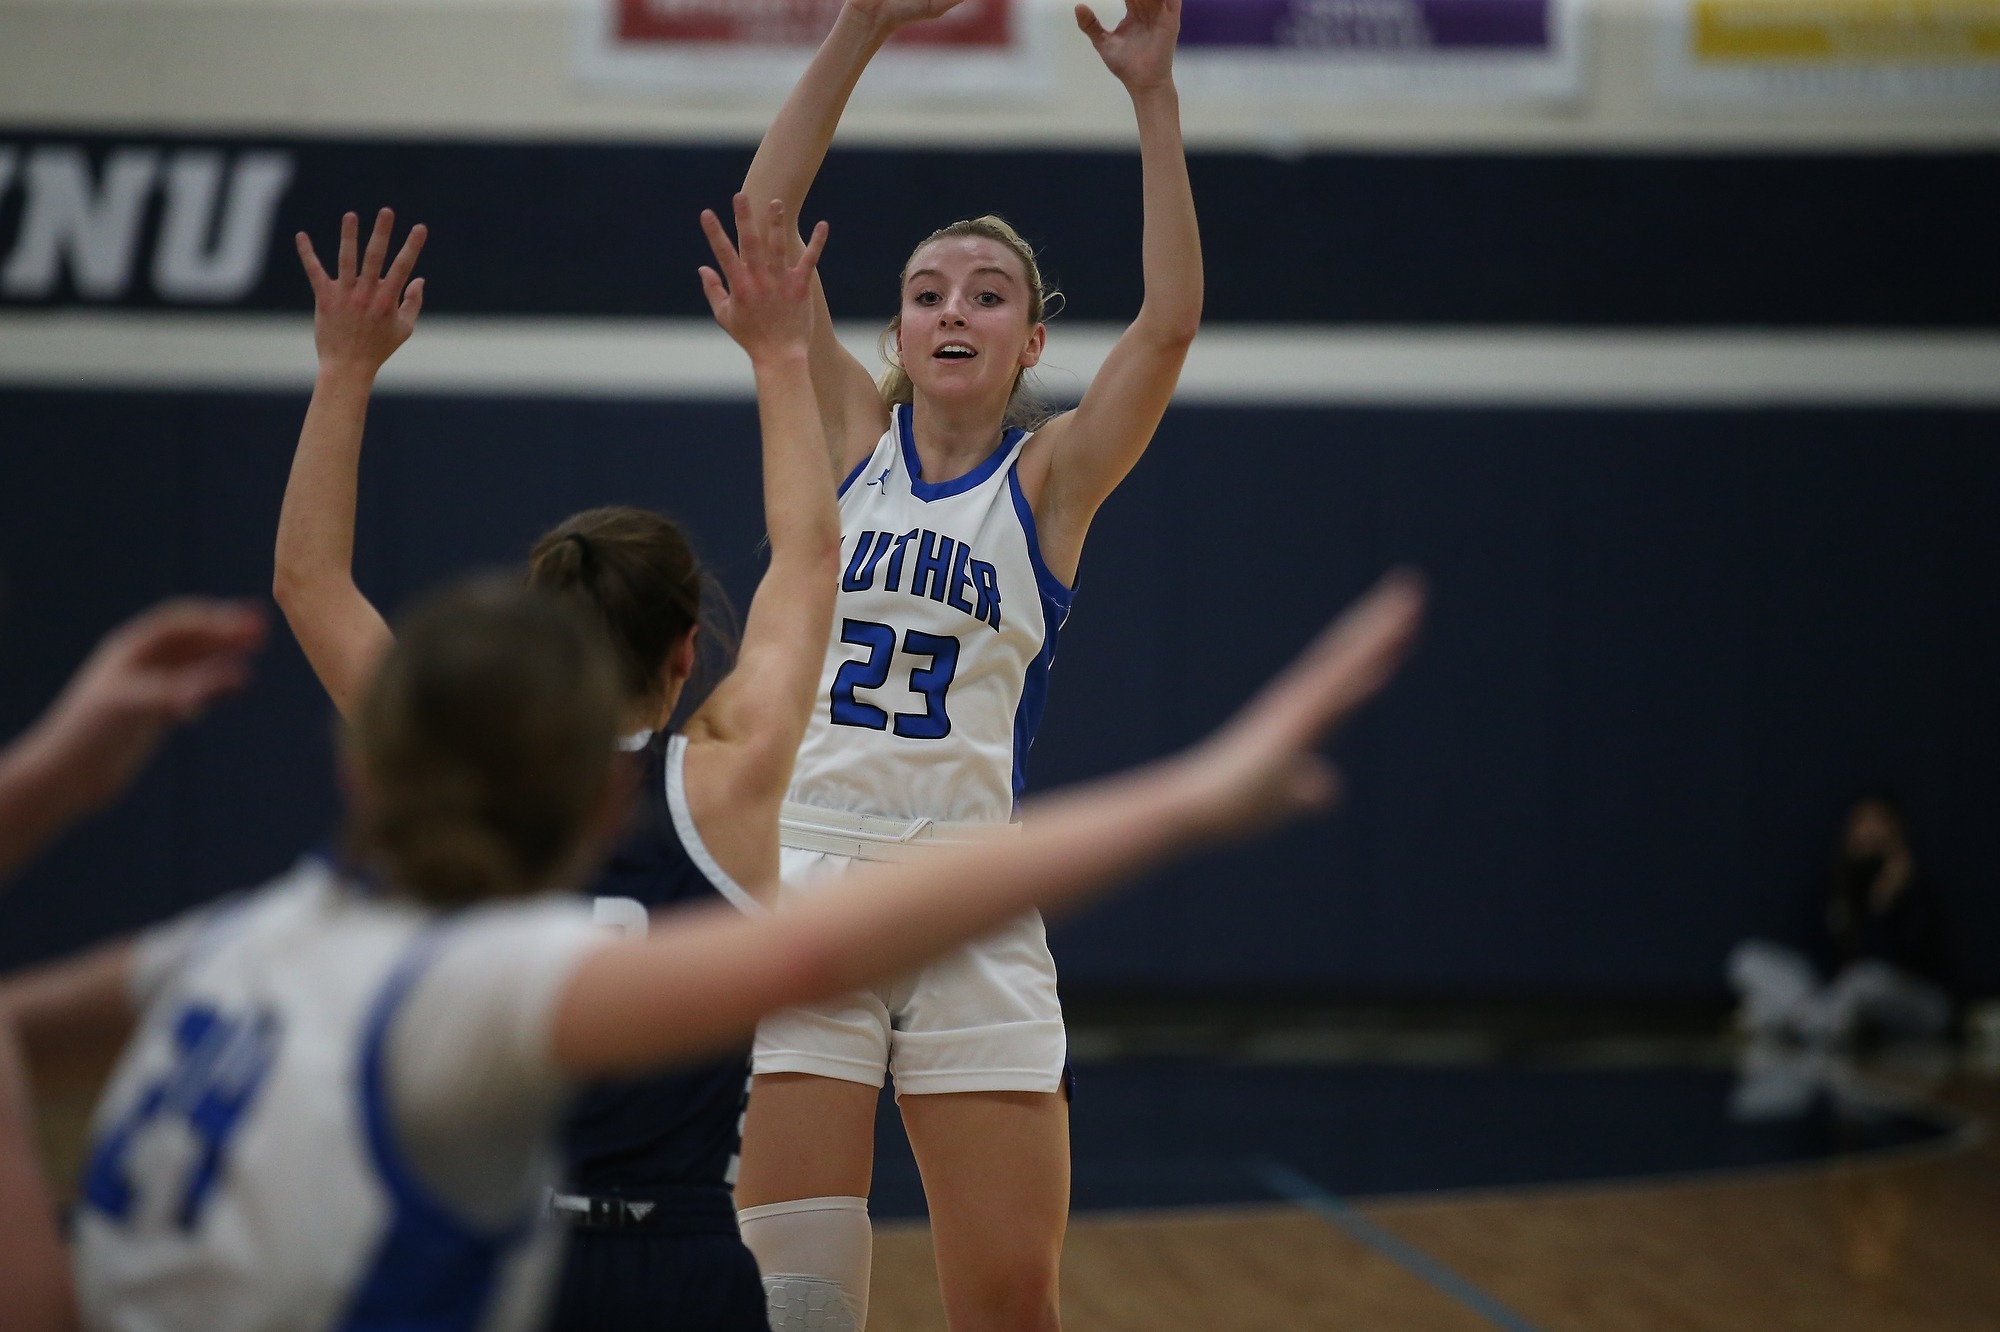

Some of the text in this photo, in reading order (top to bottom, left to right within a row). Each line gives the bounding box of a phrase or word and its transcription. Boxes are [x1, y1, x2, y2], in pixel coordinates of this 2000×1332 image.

[0, 149, 293, 301] NU
[836, 527, 1002, 634] UTHER
[829, 617, 961, 740] 23
